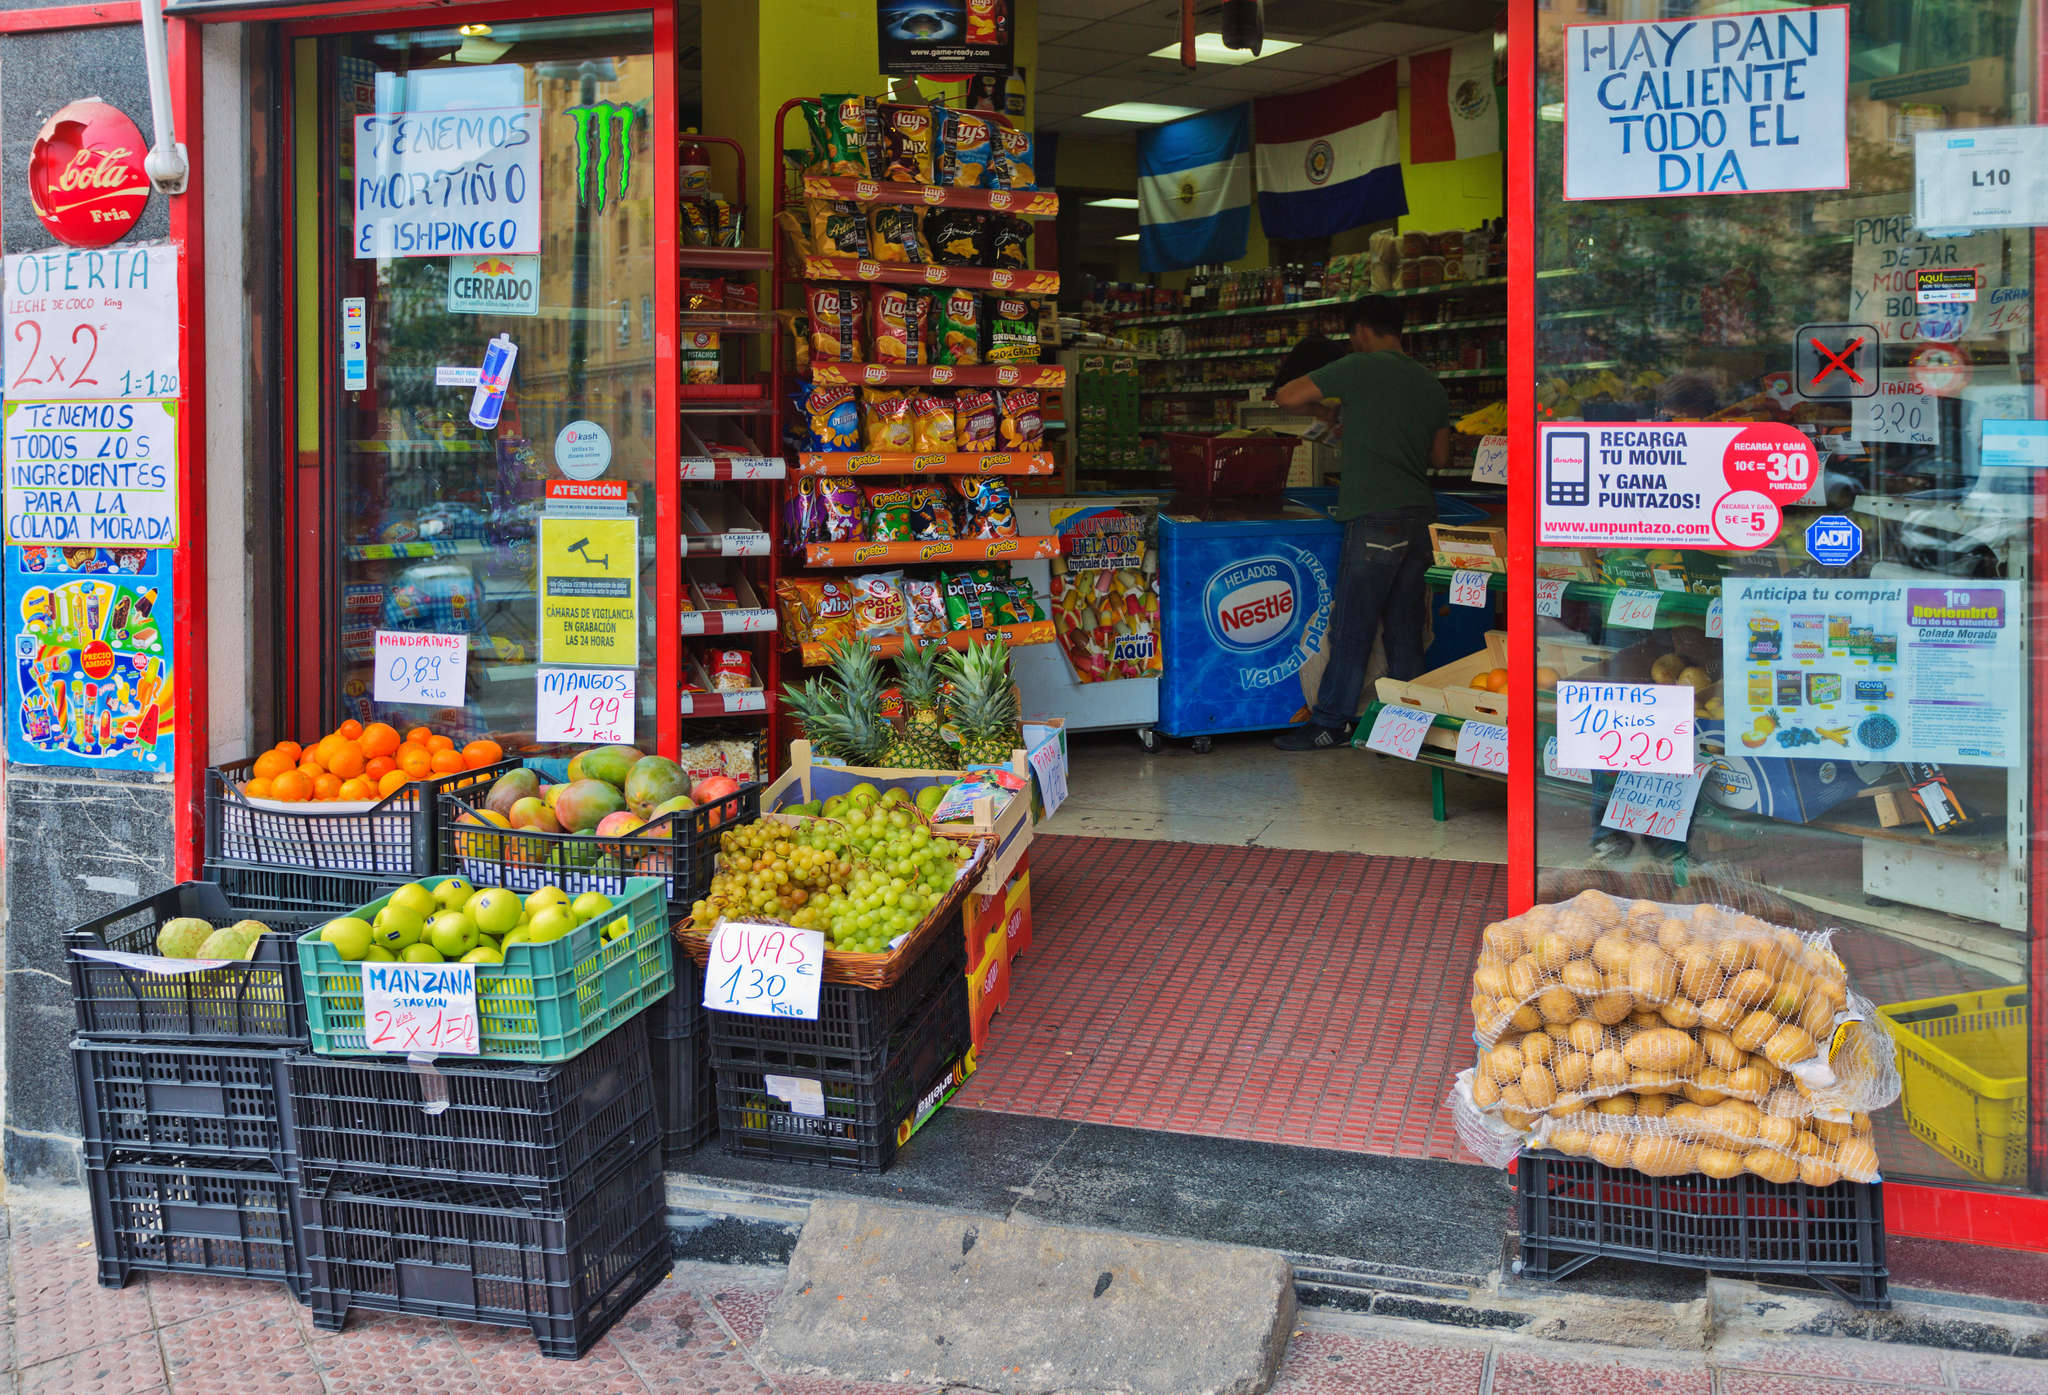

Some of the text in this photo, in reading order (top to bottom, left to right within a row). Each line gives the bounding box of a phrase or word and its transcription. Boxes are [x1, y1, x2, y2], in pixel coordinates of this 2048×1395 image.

[1582, 12, 1818, 72] HAY PAN
[1597, 58, 1807, 110] CALIENTE
[363, 113, 531, 158] TENEMOS
[1609, 104, 1799, 154] TODO EL
[1658, 150, 1748, 193] DIA
[1972, 169, 2011, 187] L10
[360, 163, 526, 210] MORTIÑO
[90, 208, 131, 223] Fria
[394, 219, 517, 250] ISHPINGO
[17, 249, 149, 295] OFERTA
[454, 277, 532, 301] CERRADO
[10, 299, 46, 315] LECHE
[52, 298, 65, 310] DE
[66, 298, 95, 310] COCO
[25, 404, 134, 429] TENEMOS
[10, 435, 150, 459] TODOS LOS
[1600, 432, 1688, 447] RECARGA
[1734, 443, 1807, 451] RECARGA Y GANA
[848, 455, 881, 473] Cheetos
[914, 454, 946, 472] Cheetos
[980, 454, 1011, 472] Cheetos
[1600, 450, 1623, 465] TU
[1629, 446, 1688, 465] MÓVIL
[12, 462, 166, 488] INGREDIENTES
[1598, 474, 1667, 490] Y GANA
[552, 483, 622, 496] ATENCIÓN
[1769, 482, 1808, 490] PUNTAZOS
[24, 491, 126, 514] PARA LA
[1599, 493, 1701, 509] PUNTAZOS!
[10, 515, 174, 541] COLADA MORADA
[1544, 521, 1710, 536] www.unpuntazo.com
[1072, 536, 1137, 555] HELADOS
[1816, 530, 1851, 547] ADT
[855, 544, 888, 563] Cheetos
[920, 542, 952, 561] Cheetos
[985, 540, 1018, 558] Cheetos
[1069, 558, 1100, 571] tropicales
[1224, 565, 1278, 590] HELADOS
[1741, 587, 1902, 605] Anticipa tu compra!
[546, 604, 634, 620] CÁMARAS DE VIGILANCIA
[564, 620, 616, 633] EN GRABACIÓN
[1918, 628, 1997, 639] Colada Morada
[379, 634, 460, 649] MANDARINAS
[565, 635, 615, 647] LAS 24 HORAS
[84, 652, 112, 661] PRECIO
[85, 659, 112, 668] AMIGO
[390, 656, 442, 692] 0,89
[543, 672, 627, 695] MANGOS
[1240, 667, 1284, 690] Ven
[1559, 685, 1657, 705] PATATAS
[555, 695, 620, 739] 1,99
[1569, 704, 1609, 735] 10
[1599, 730, 1674, 768] 2,20
[1616, 771, 1683, 798] PATATAS
[1612, 787, 1682, 811] PEQUEÑAS
[720, 928, 805, 965] UVAS
[369, 968, 473, 995] MANZANA
[720, 965, 786, 1006] 1,30
[373, 1010, 396, 1045] 2
